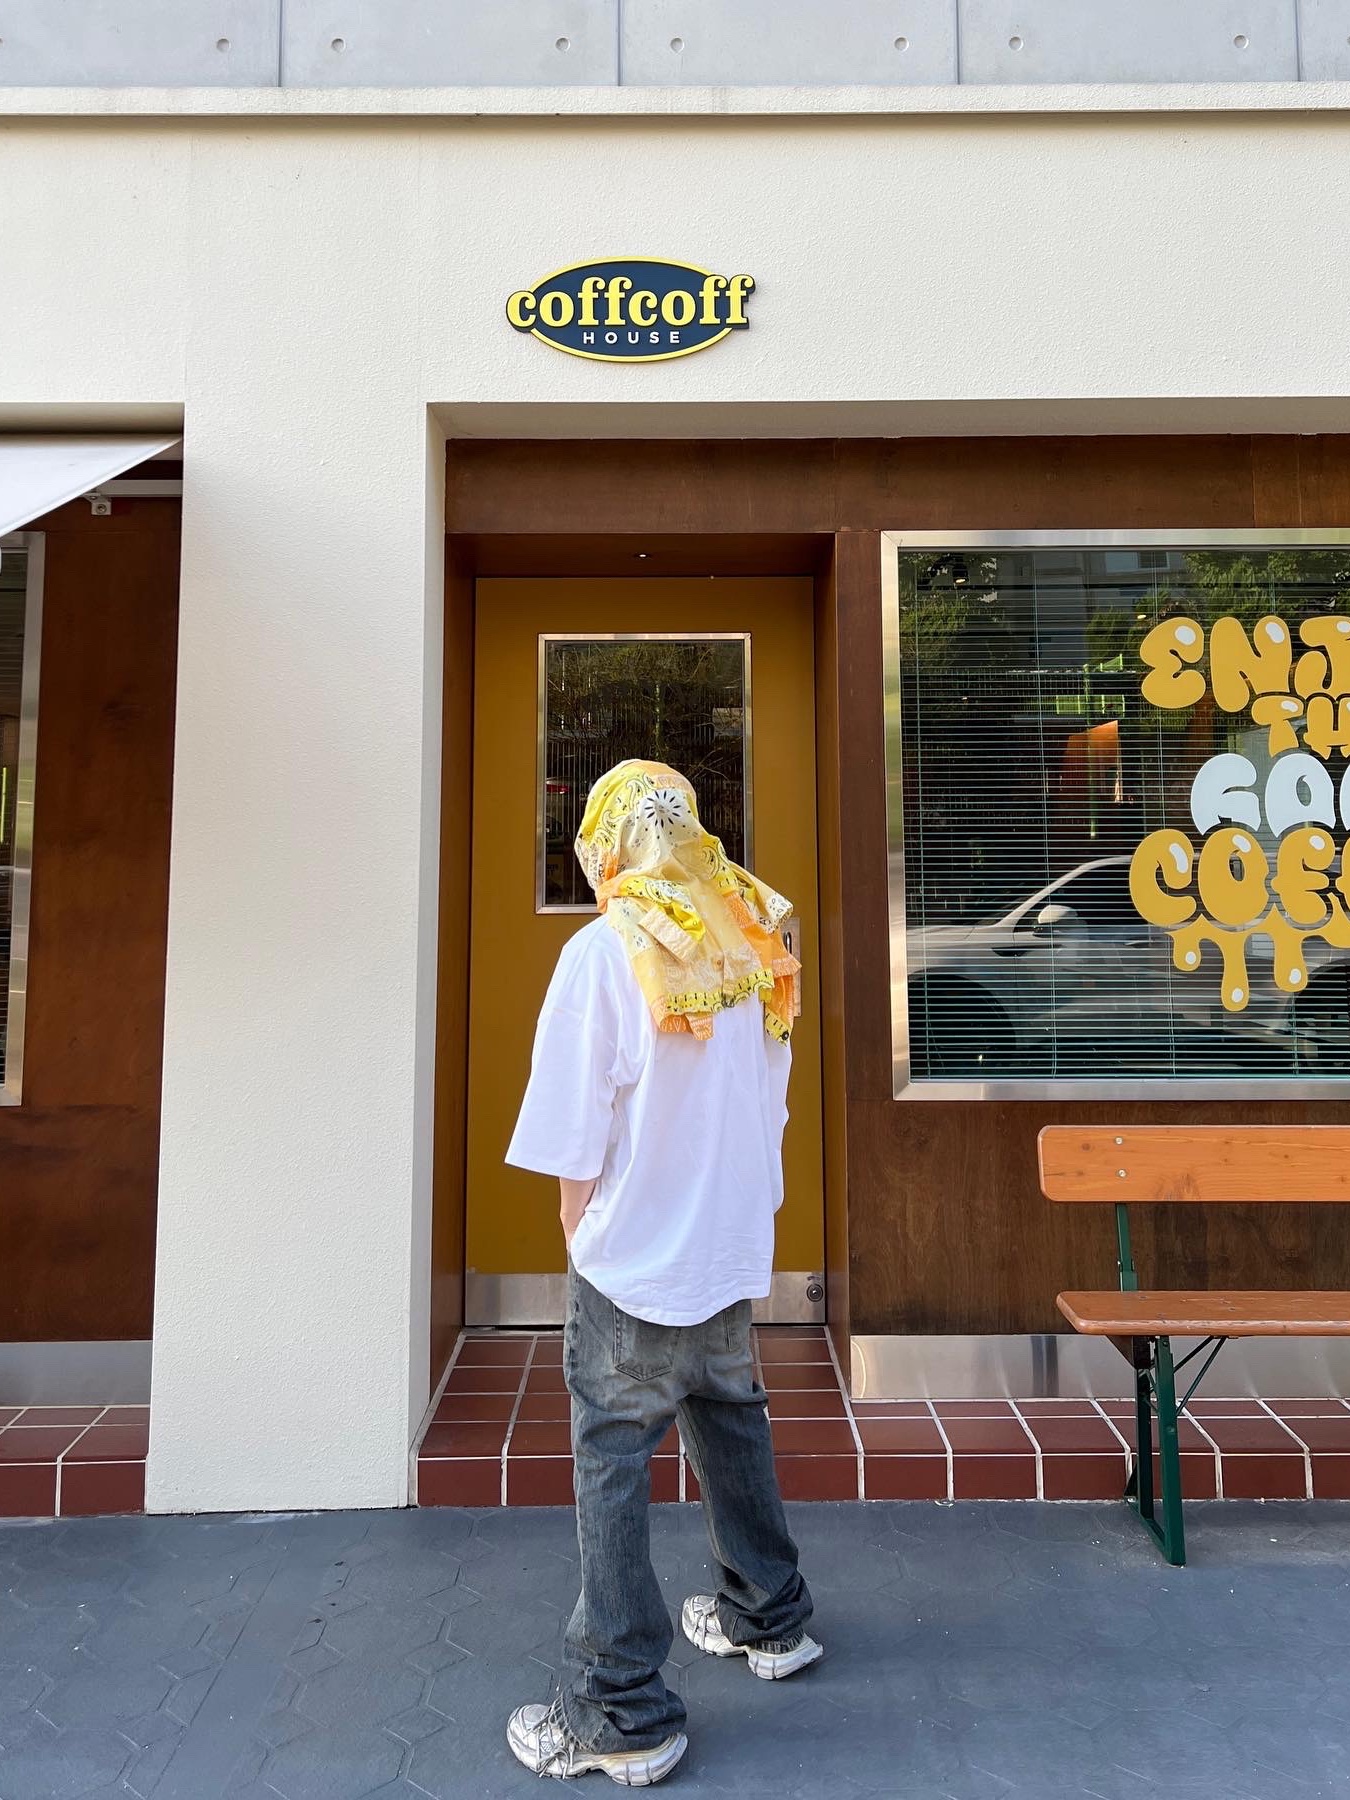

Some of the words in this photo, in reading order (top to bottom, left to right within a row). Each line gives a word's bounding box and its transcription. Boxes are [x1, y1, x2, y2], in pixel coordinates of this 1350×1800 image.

[507, 274, 754, 328] coffcoff
[583, 331, 681, 345] HOUSE
[1190, 752, 1350, 838] GO
[1129, 827, 1350, 927] COF
